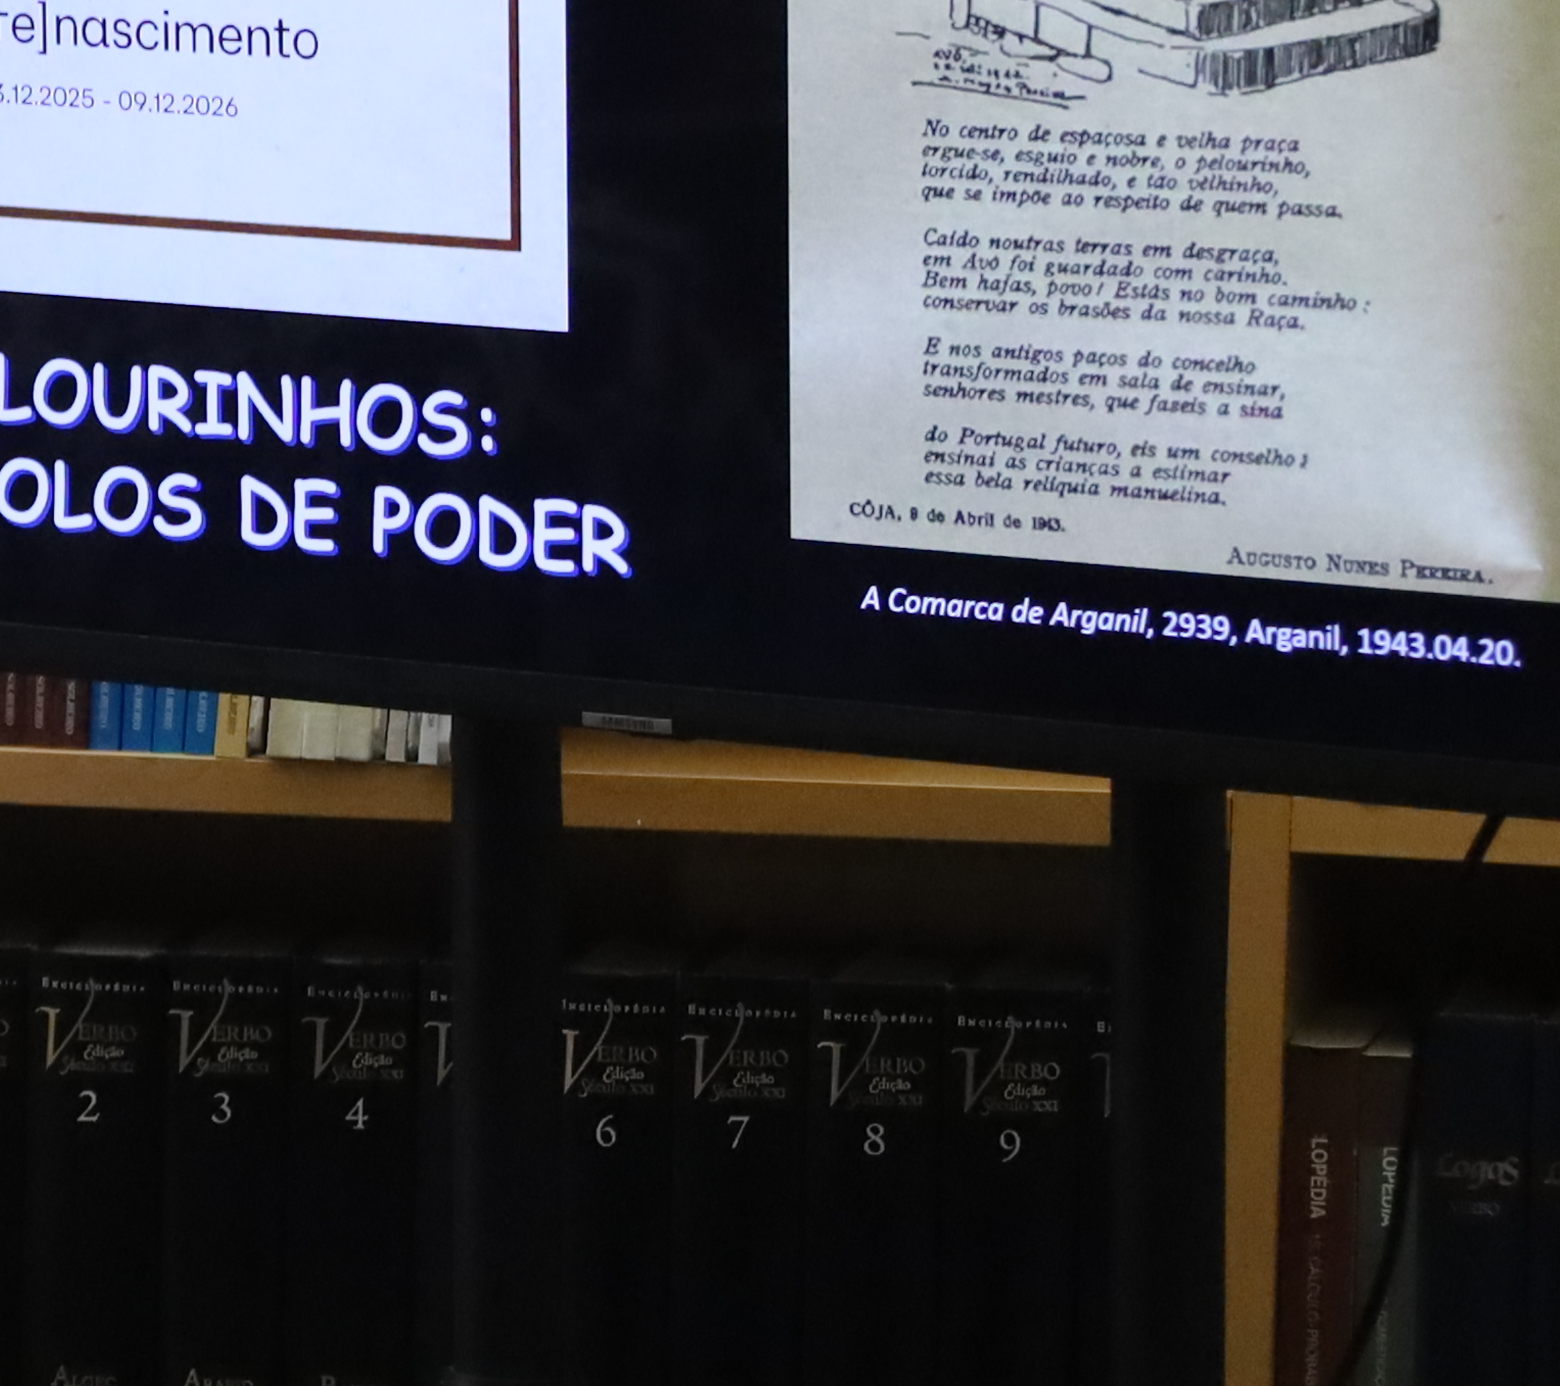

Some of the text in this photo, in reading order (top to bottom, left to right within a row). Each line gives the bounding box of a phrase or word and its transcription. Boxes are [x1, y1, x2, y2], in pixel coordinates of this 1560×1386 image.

[118, 90, 239, 119] 09.12.2026
[922, 118, 949, 138] No
[959, 120, 1018, 141] centro
[1028, 123, 1051, 143] de
[1060, 130, 1146, 152] espaçosa
[1176, 129, 1230, 151] velha
[1241, 138, 1299, 159] praça
[1015, 144, 1077, 170] esguio
[1196, 152, 1310, 181] pelourinho,
[1003, 164, 1116, 193] rendilhado,
[1188, 173, 1278, 200] velhinho,
[922, 186, 955, 206] que
[964, 188, 982, 202] se
[1062, 193, 1084, 207] ao
[1094, 188, 1170, 217] respeito
[1180, 193, 1204, 213] de
[1213, 200, 1267, 221] quem
[989, 231, 1064, 253] noutras
[1075, 235, 1133, 256] terras
[1142, 245, 1171, 258] em
[1183, 241, 1278, 269] desgraça,
[923, 254, 951, 268] em
[1009, 253, 1035, 277] foi
[1045, 255, 1143, 283] guardado
[1154, 267, 1193, 281] com
[1204, 263, 1287, 286] carinho.
[922, 268, 967, 290] Bem
[1180, 289, 1204, 303] no
[1215, 284, 1256, 306] bom
[1268, 287, 1357, 312] caminho
[923, 296, 1019, 315] conservar
[1029, 302, 1048, 317] os
[1141, 303, 1166, 324] da
[1179, 311, 1235, 328] nossa
[925, 424, 1295, 468] do Portugal futuro, eis um conselho
[924, 445, 995, 468] ensinai
[1005, 457, 1026, 471] as
[1036, 453, 1120, 482] crianças
[1153, 461, 1231, 485] estimar
[924, 472, 965, 487] essa
[975, 470, 1012, 491] bela
[1110, 480, 1226, 506] manuelina.
[241, 477, 338, 554] DE
[372, 486, 633, 577] PODER
[954, 510, 995, 528] Abril
[1004, 512, 1021, 529] de
[1227, 546, 1317, 571] AUGUSTO
[1326, 553, 1390, 577] NUNES
[861, 587, 1522, 668] A Comarca de Arganil, 2939, Arganil, 1943.04.20.
[77, 1091, 100, 1122] 2
[211, 1093, 232, 1123] 3
[345, 1098, 368, 1131] 4
[594, 1113, 618, 1150] 6
[726, 1115, 750, 1151] 7
[863, 1123, 886, 1157] 8
[999, 1128, 1022, 1163] 9
